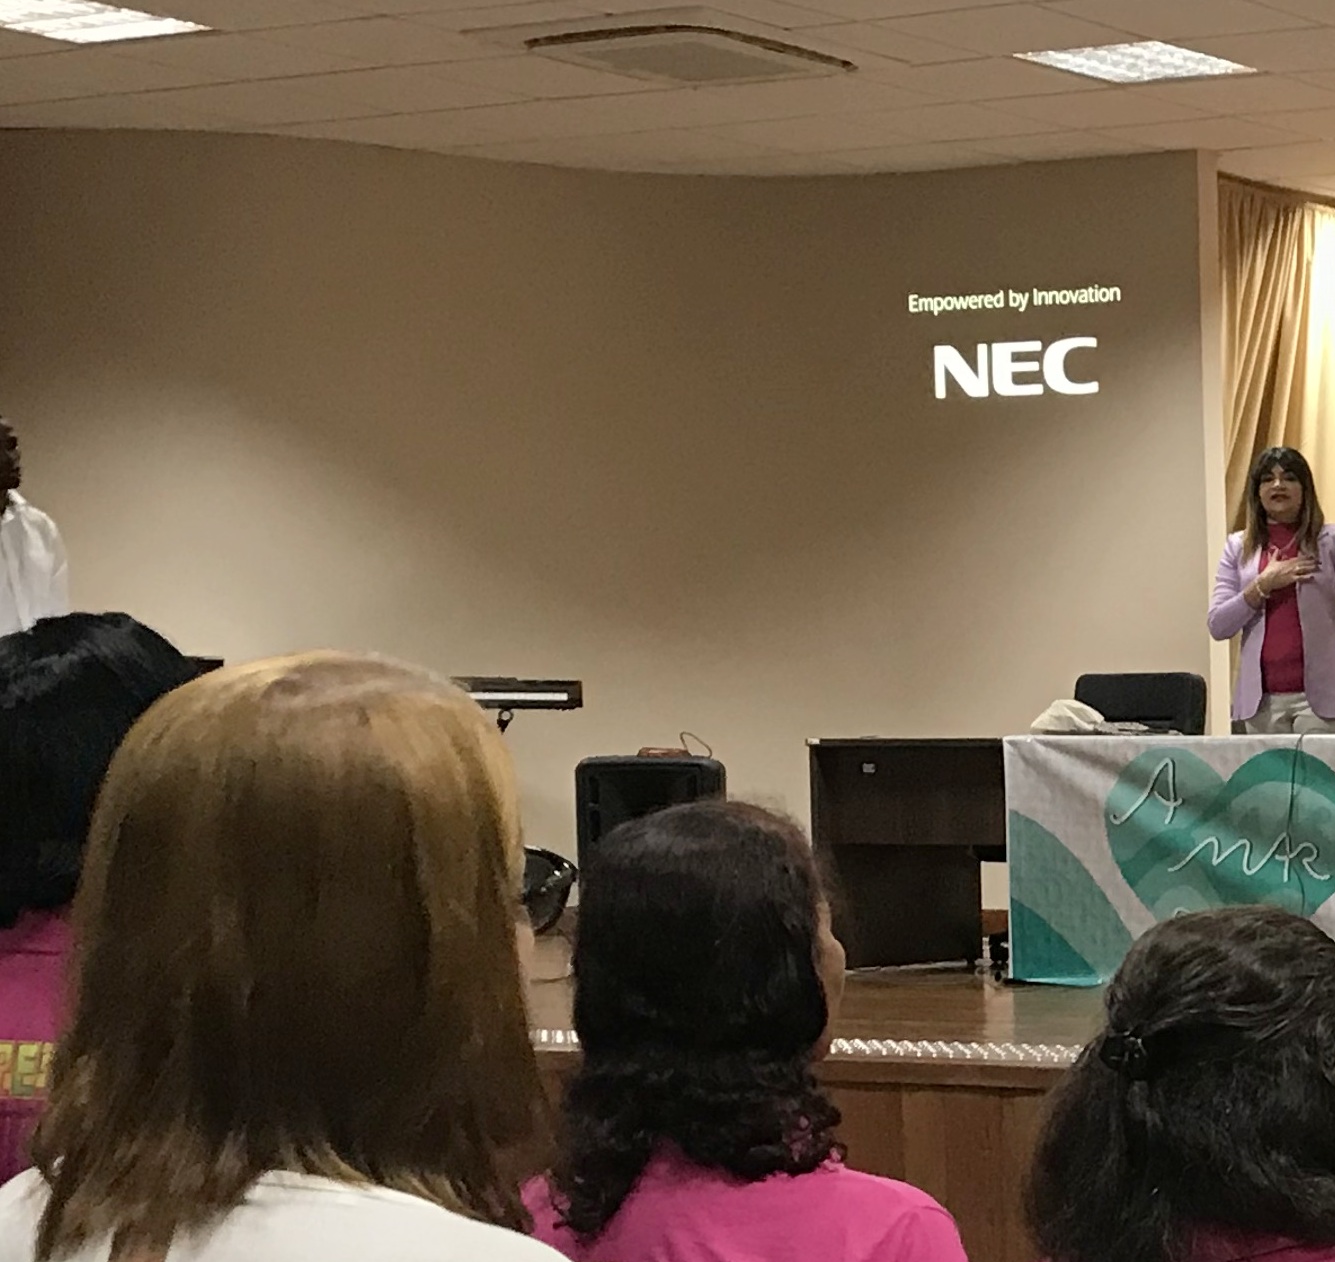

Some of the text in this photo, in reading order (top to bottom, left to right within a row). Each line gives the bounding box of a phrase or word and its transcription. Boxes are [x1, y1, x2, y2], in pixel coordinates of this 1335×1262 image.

[908, 284, 1121, 316] Empowered by Innovation
[933, 336, 1100, 399] NEC
